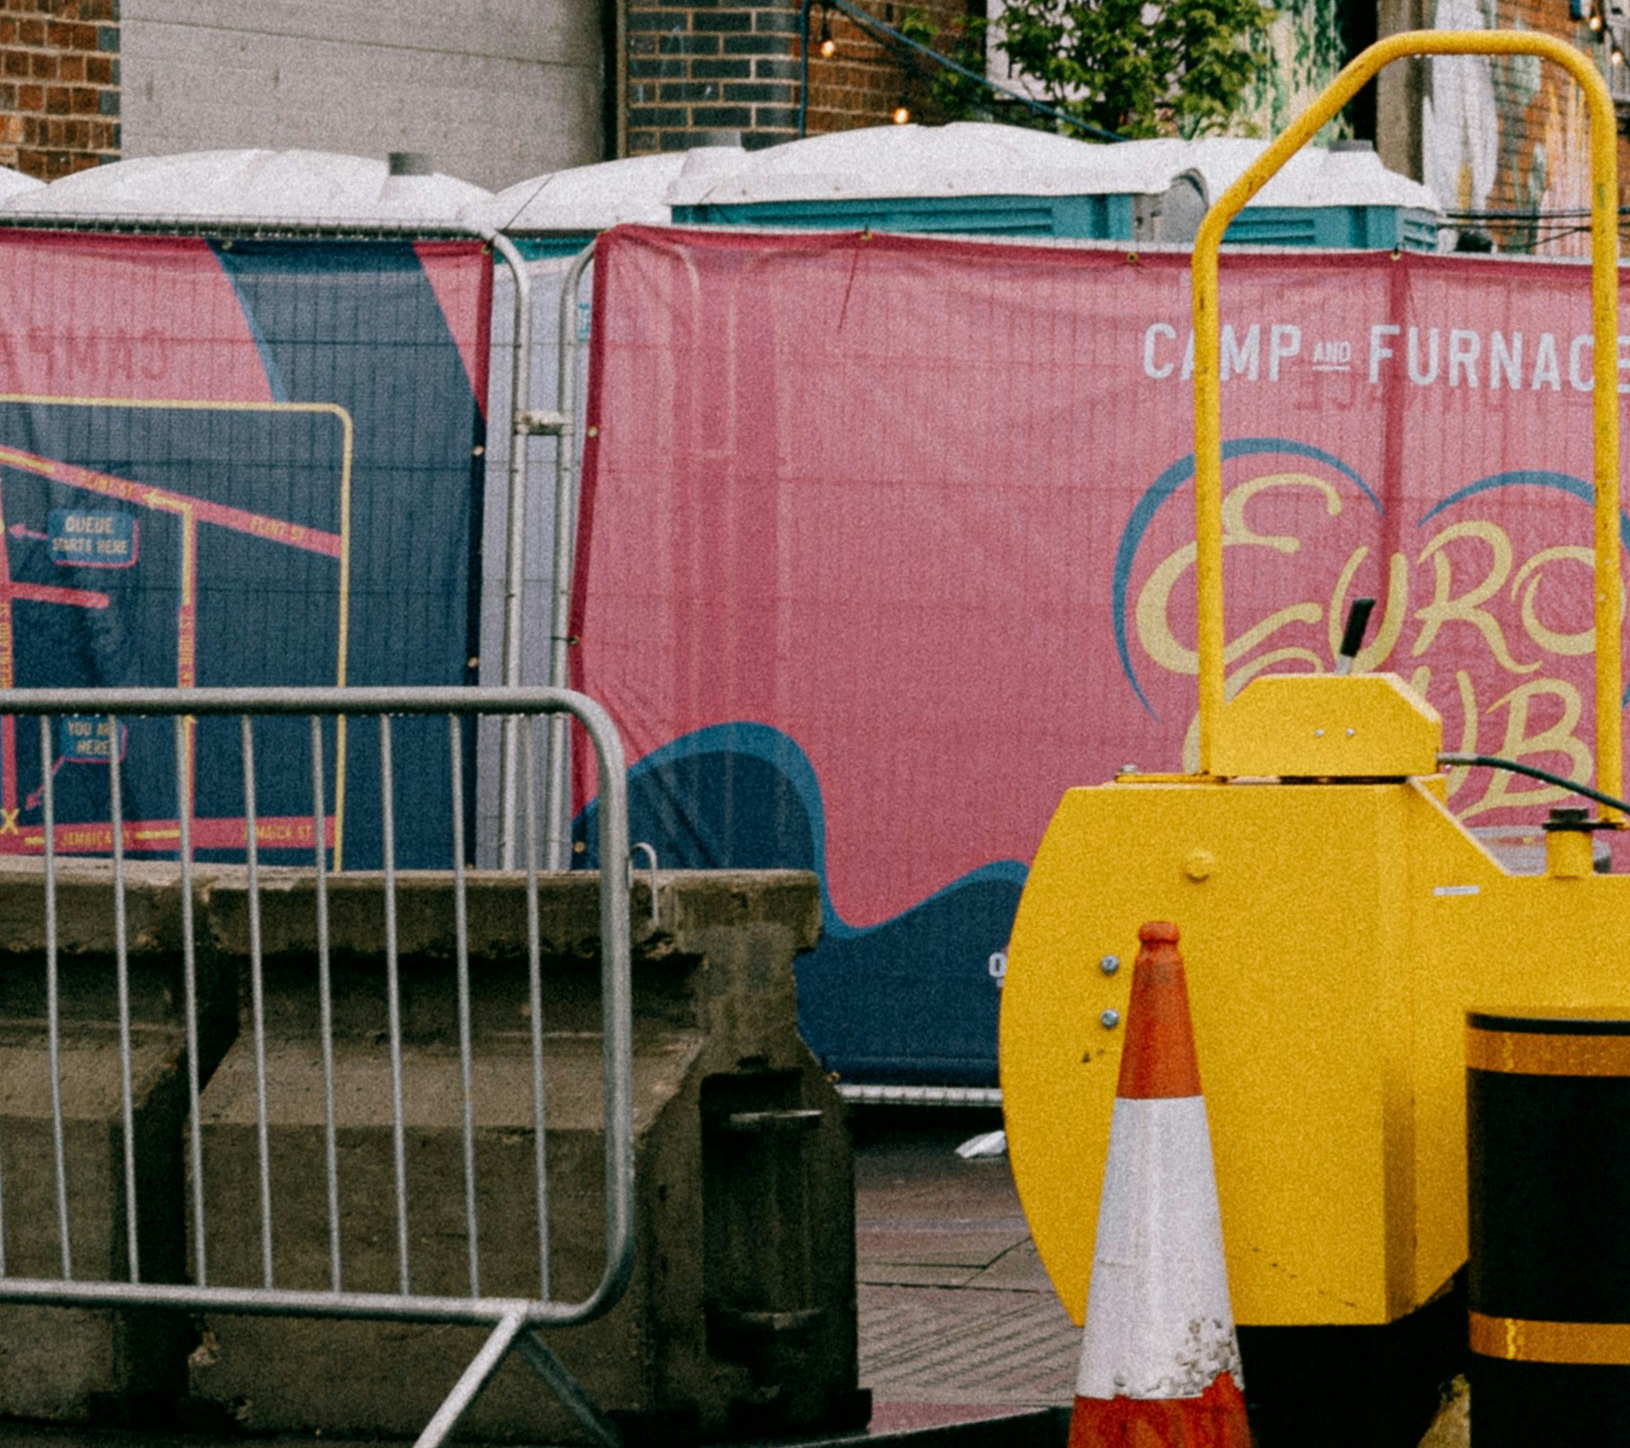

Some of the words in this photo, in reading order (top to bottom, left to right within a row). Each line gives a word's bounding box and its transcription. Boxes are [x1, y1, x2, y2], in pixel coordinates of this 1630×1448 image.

[1313, 341, 1351, 363] AND
[64, 514, 114, 533] QUEUE
[52, 538, 92, 553] STARTS
[97, 538, 127, 554] HERE
[67, 721, 92, 736] YOU
